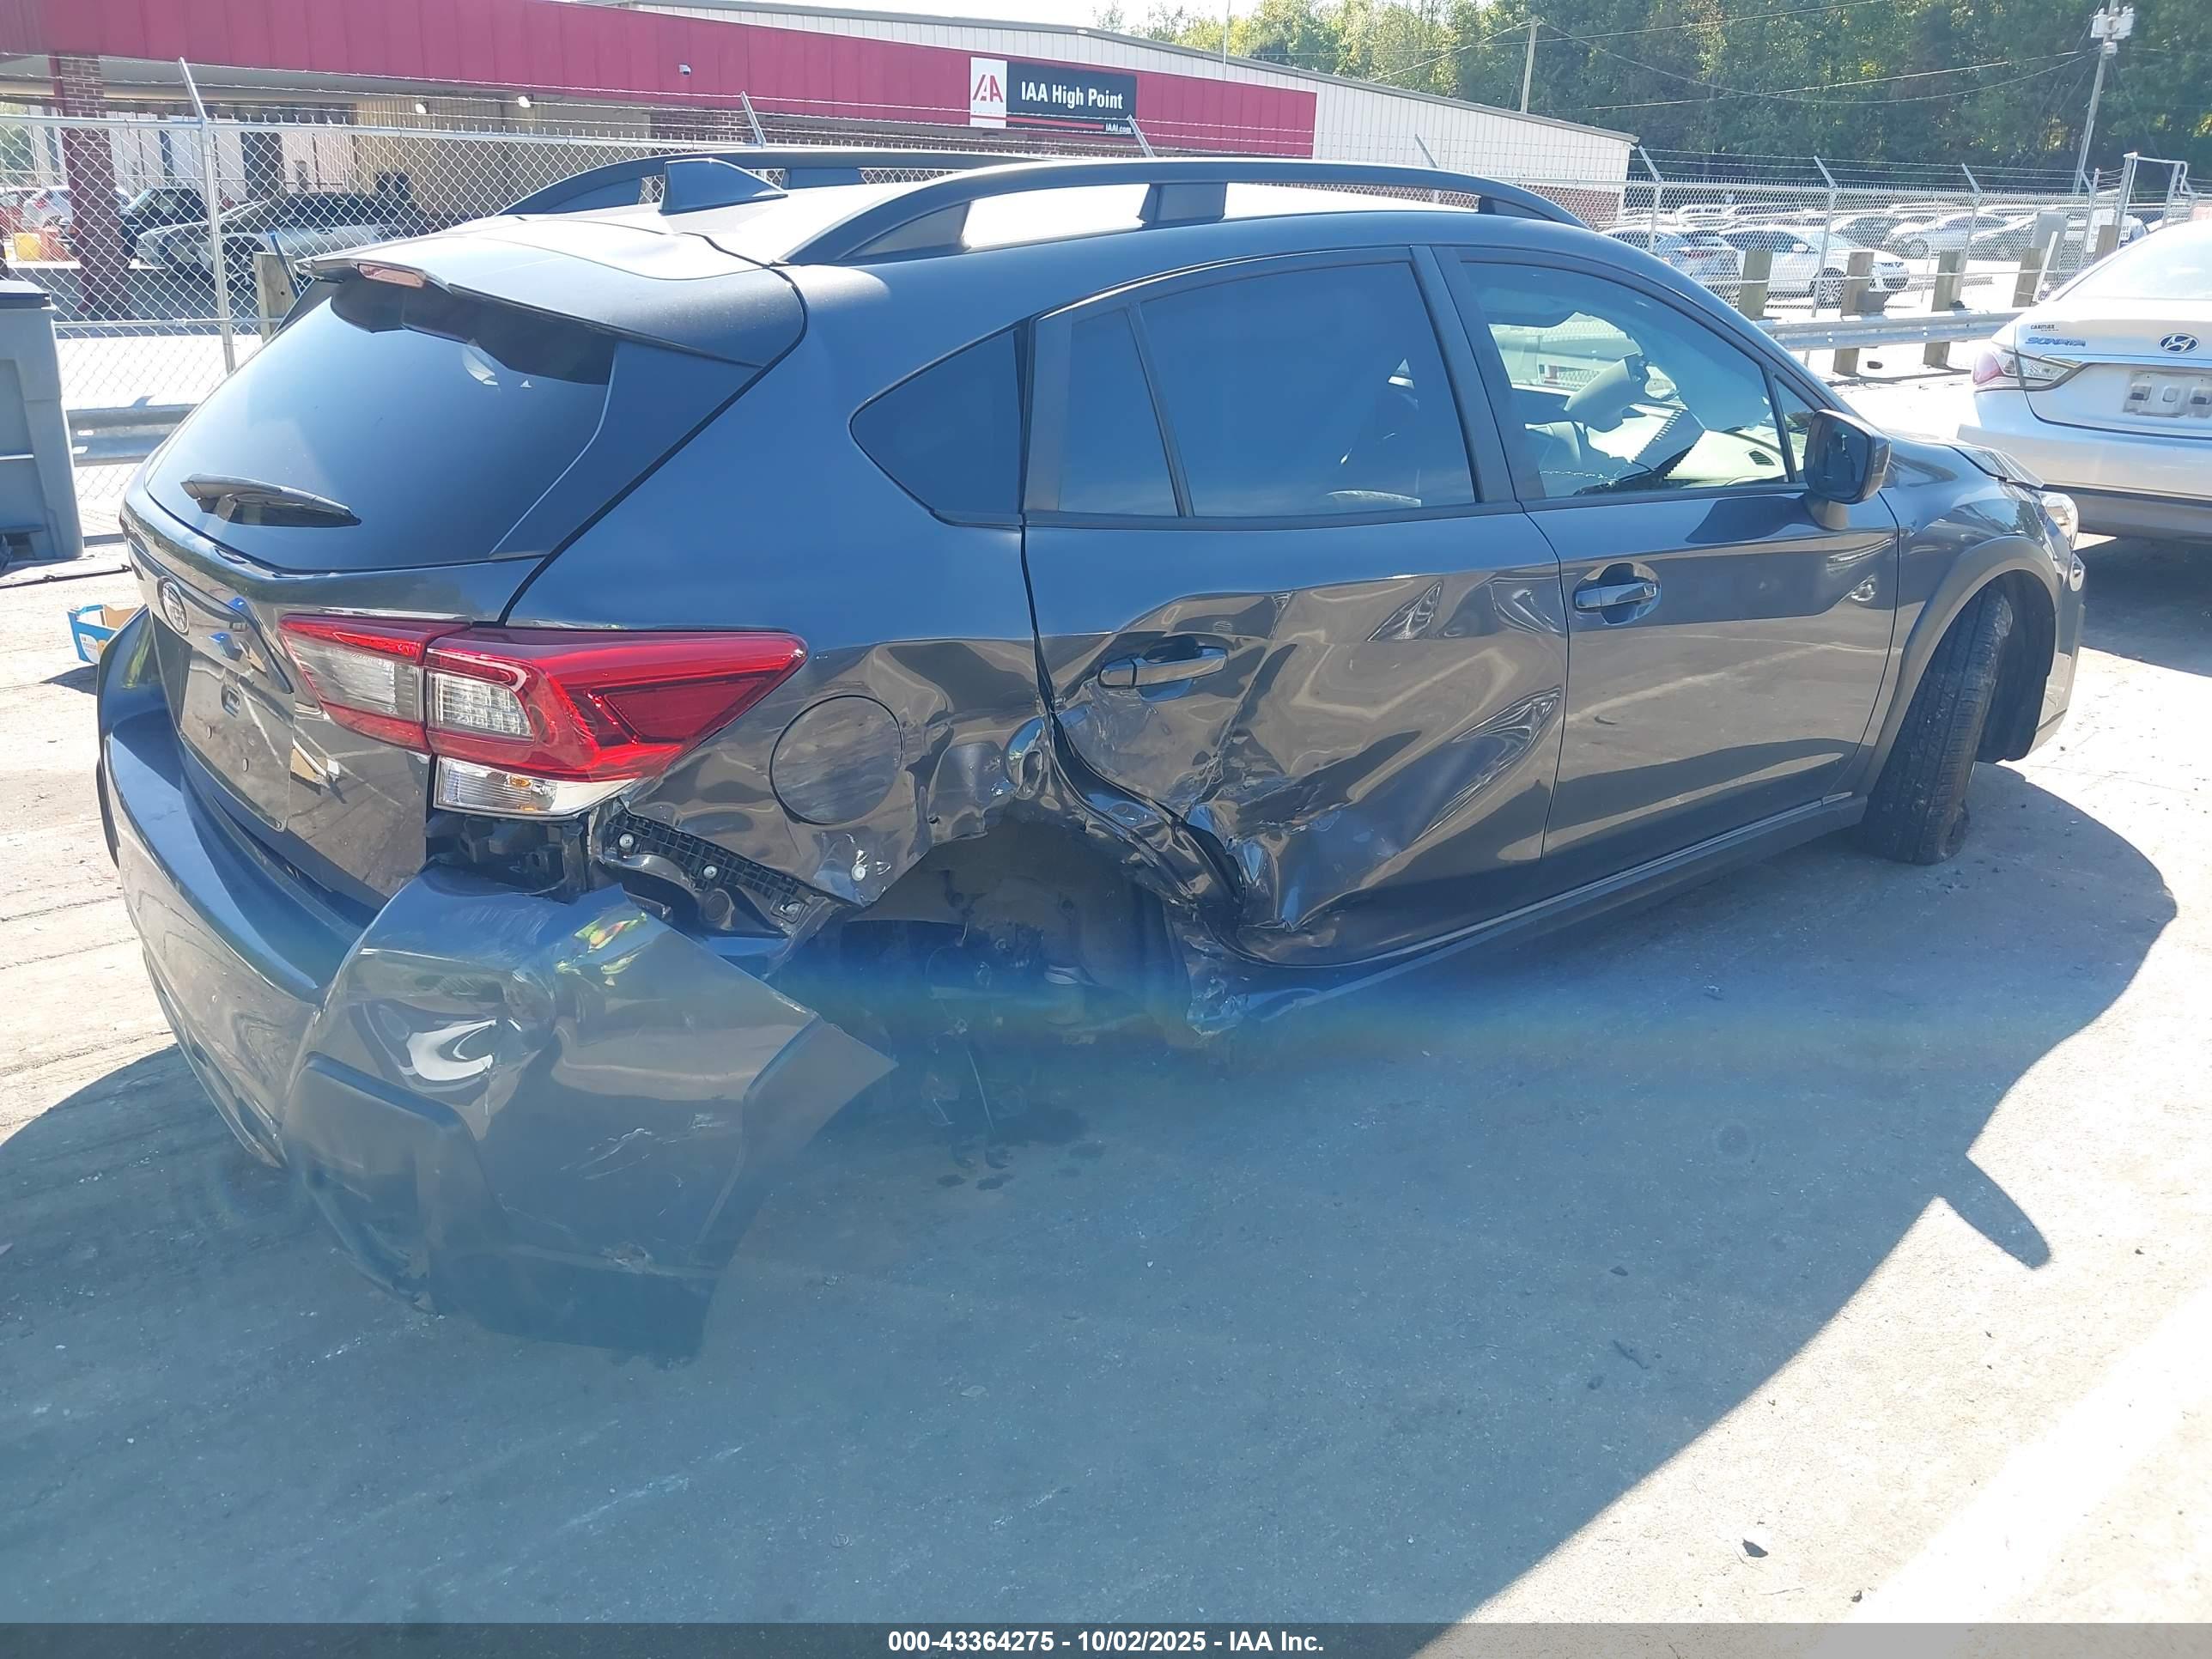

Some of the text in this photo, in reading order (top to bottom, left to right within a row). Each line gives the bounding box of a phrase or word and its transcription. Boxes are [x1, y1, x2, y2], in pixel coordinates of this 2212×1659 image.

[1021, 81, 1123, 110] IAA High Point
